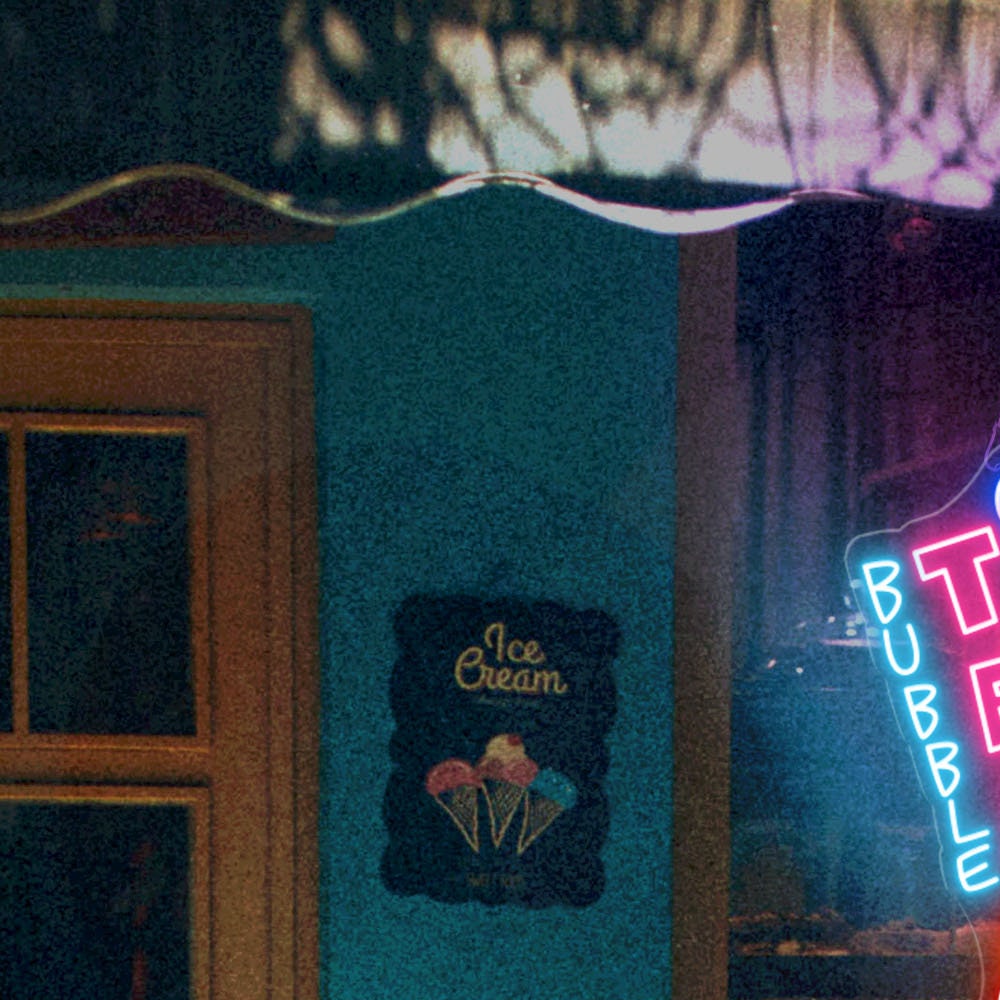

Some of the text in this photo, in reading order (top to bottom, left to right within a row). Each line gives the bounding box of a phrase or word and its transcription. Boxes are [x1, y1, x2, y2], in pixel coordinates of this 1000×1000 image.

[484, 621, 545, 662] Ice
[454, 647, 568, 695] Cream
[862, 560, 999, 892] BUBBLE
